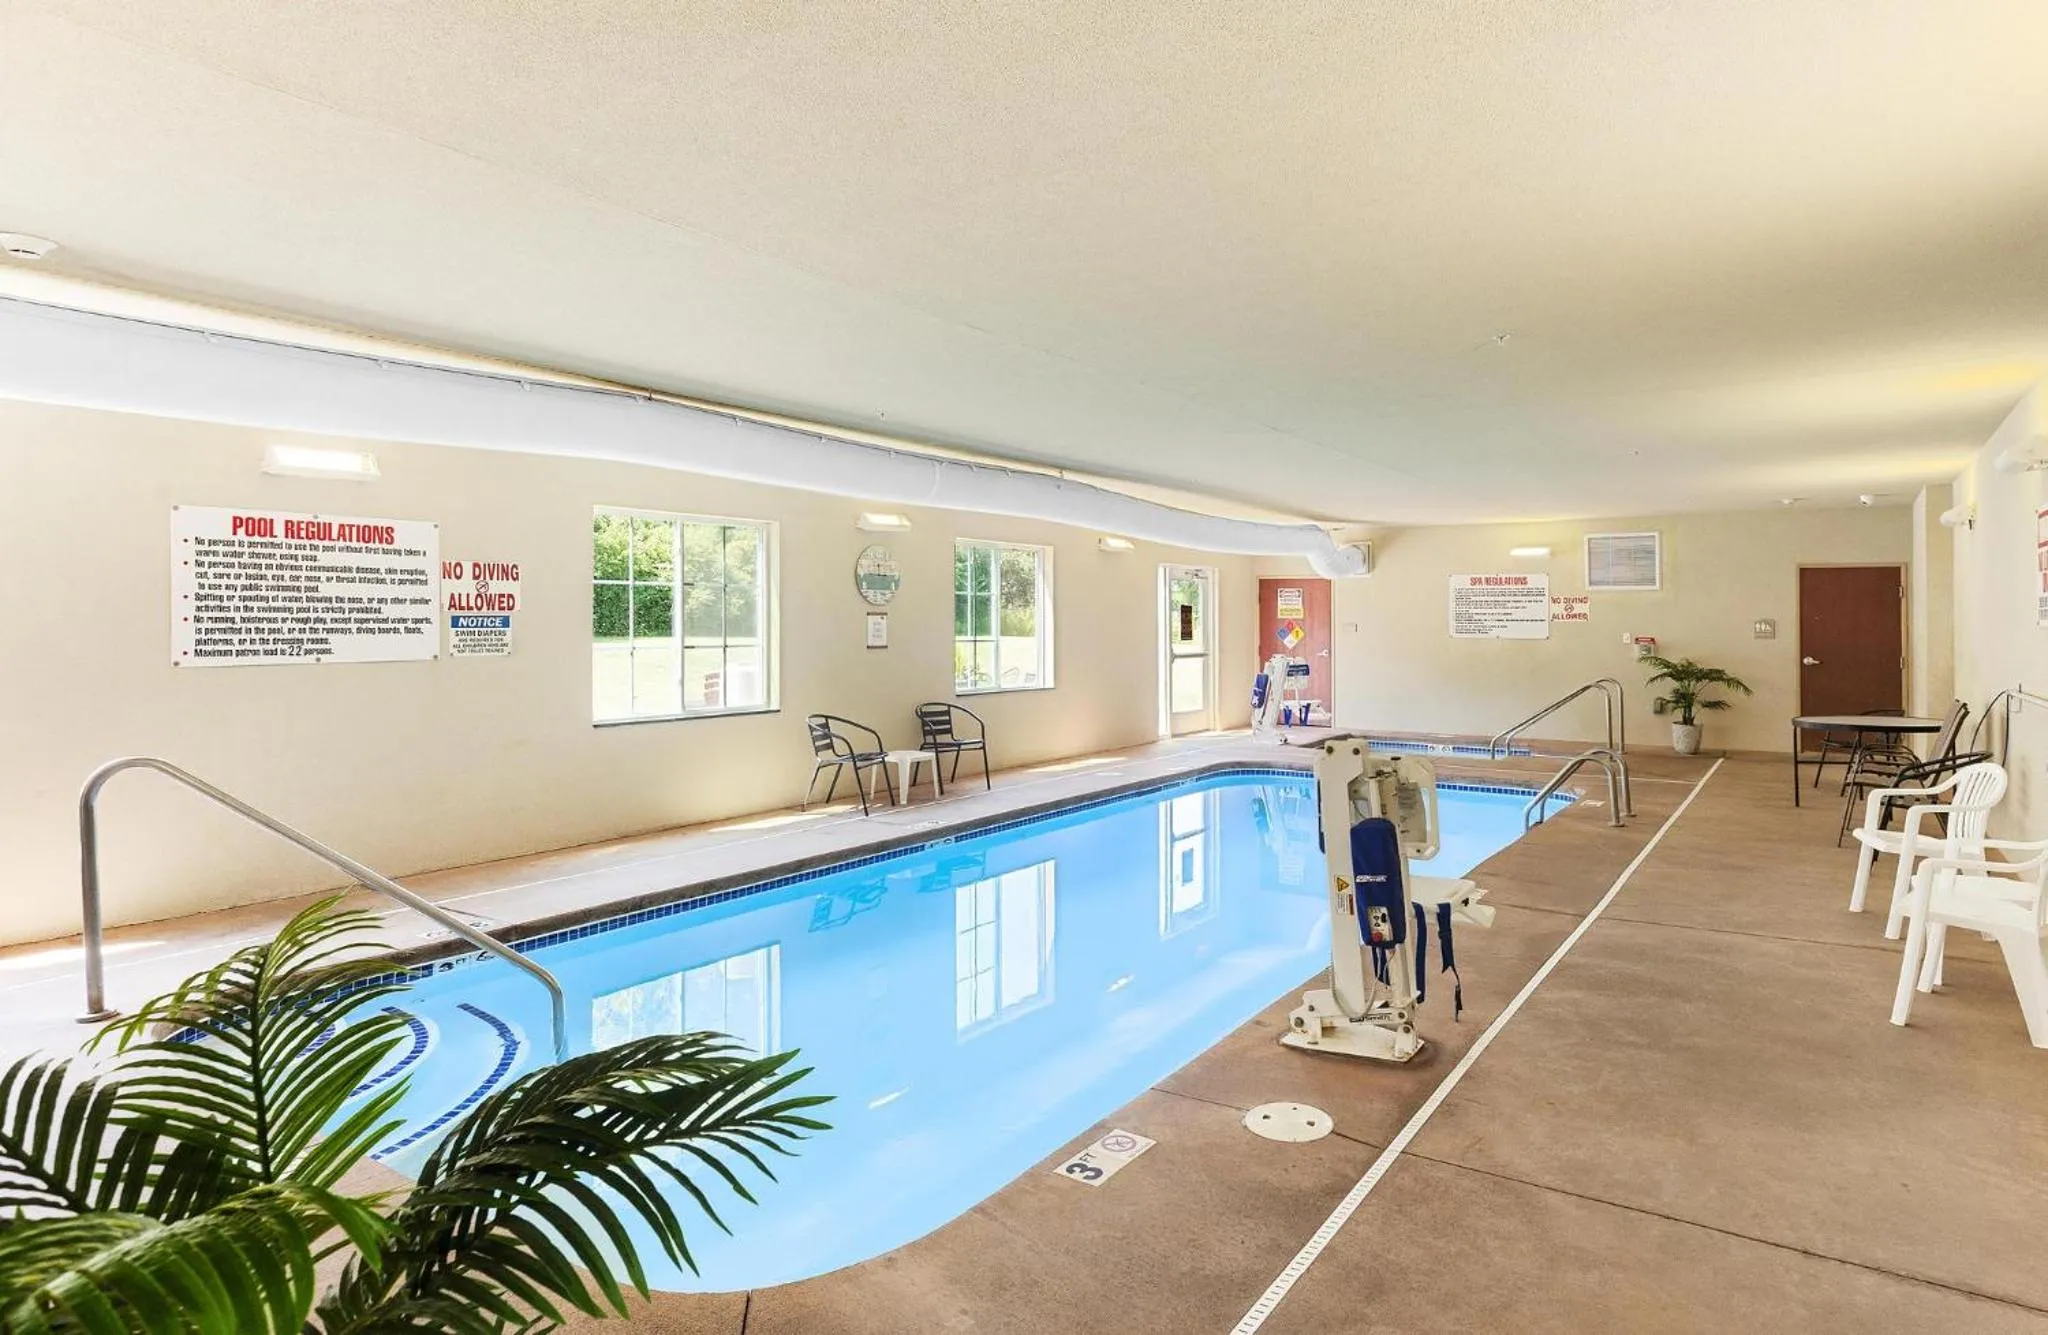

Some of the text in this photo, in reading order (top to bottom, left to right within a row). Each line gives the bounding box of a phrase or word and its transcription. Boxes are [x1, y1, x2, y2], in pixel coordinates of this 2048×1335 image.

[232, 516, 394, 545] POOL REGULATIONS
[195, 536, 205, 546] No
[208, 538, 235, 547] person
[238, 540, 245, 548] is
[247, 541, 283, 550] permitted
[285, 542, 292, 550] to
[322, 544, 336, 552] pool
[365, 546, 379, 554] first
[382, 548, 402, 556] having
[222, 550, 246, 558] water
[248, 551, 278, 560] shower,
[280, 553, 298, 562] using
[195, 559, 205, 568] No
[208, 560, 236, 570] person
[238, 562, 262, 571] having
[276, 562, 302, 571] obvious
[306, 564, 354, 574] communicable
[356, 566, 382, 574] disease,
[400, 568, 428, 576] eruption,
[442, 562, 519, 581] NO DIVING
[1470, 576, 1528, 586] SPA REGULATIONS
[194, 592, 224, 602] Spitting
[238, 594, 270, 604] spouting
[282, 595, 304, 604] water,
[306, 596, 333, 604] blowing
[377, 598, 388, 606] any
[448, 592, 515, 611] ALLOWED
[195, 604, 231, 612] activities
[242, 604, 254, 613] the
[256, 605, 294, 614] swimming
[296, 606, 310, 614] pool
[321, 606, 346, 614] strictly
[458, 616, 504, 626] NOTICE
[1551, 613, 1588, 621] ALLOWED
[205, 627, 242, 636] permitted
[268, 627, 285, 636] pool,
[356, 626, 376, 635] diving
[378, 626, 402, 634] boards,
[195, 638, 235, 647] platforms,
[272, 638, 304, 646] dressing
[194, 648, 232, 657] Maximum
[288, 646, 302, 656] 22
[304, 648, 334, 656] persons.
[1066, 1152, 1104, 1180] 3 FT
